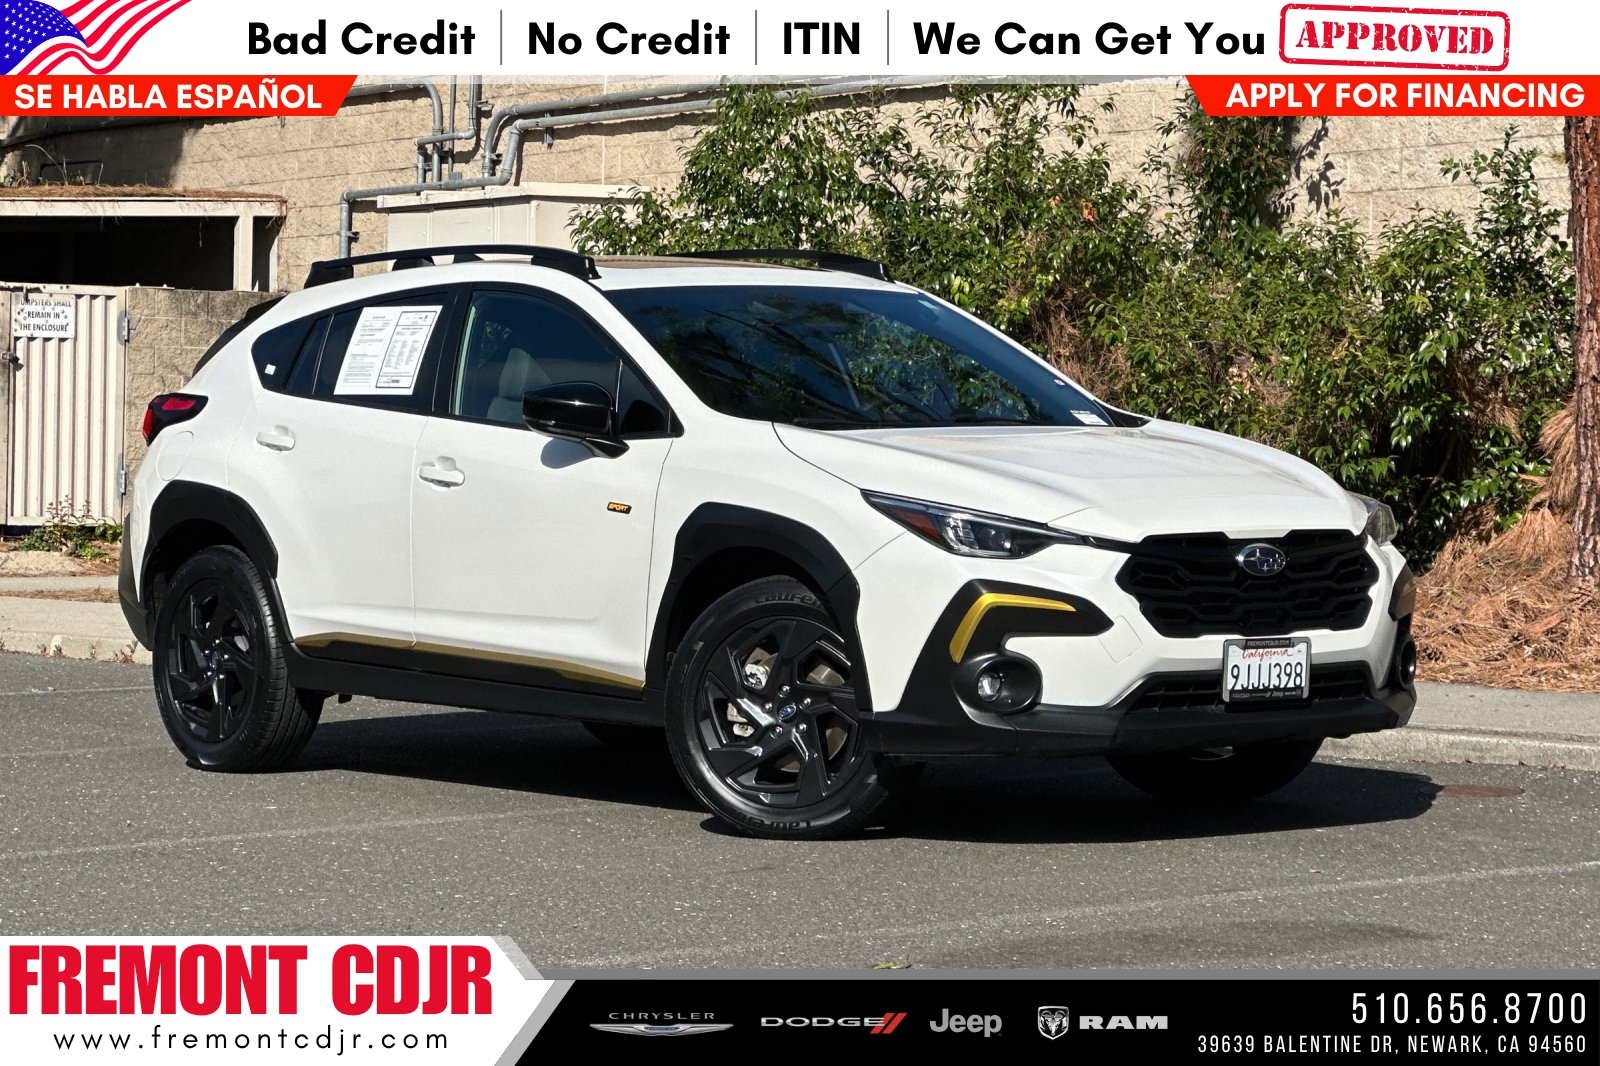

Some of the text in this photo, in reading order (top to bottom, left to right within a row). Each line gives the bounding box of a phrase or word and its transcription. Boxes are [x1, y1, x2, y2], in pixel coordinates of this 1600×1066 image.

[27, 310, 60, 319] REMAIN IN
[20, 323, 69, 332] THE ENCLOSURE
[1242, 648, 1293, 662] California
[1230, 661, 1303, 690] 9JJJ398
